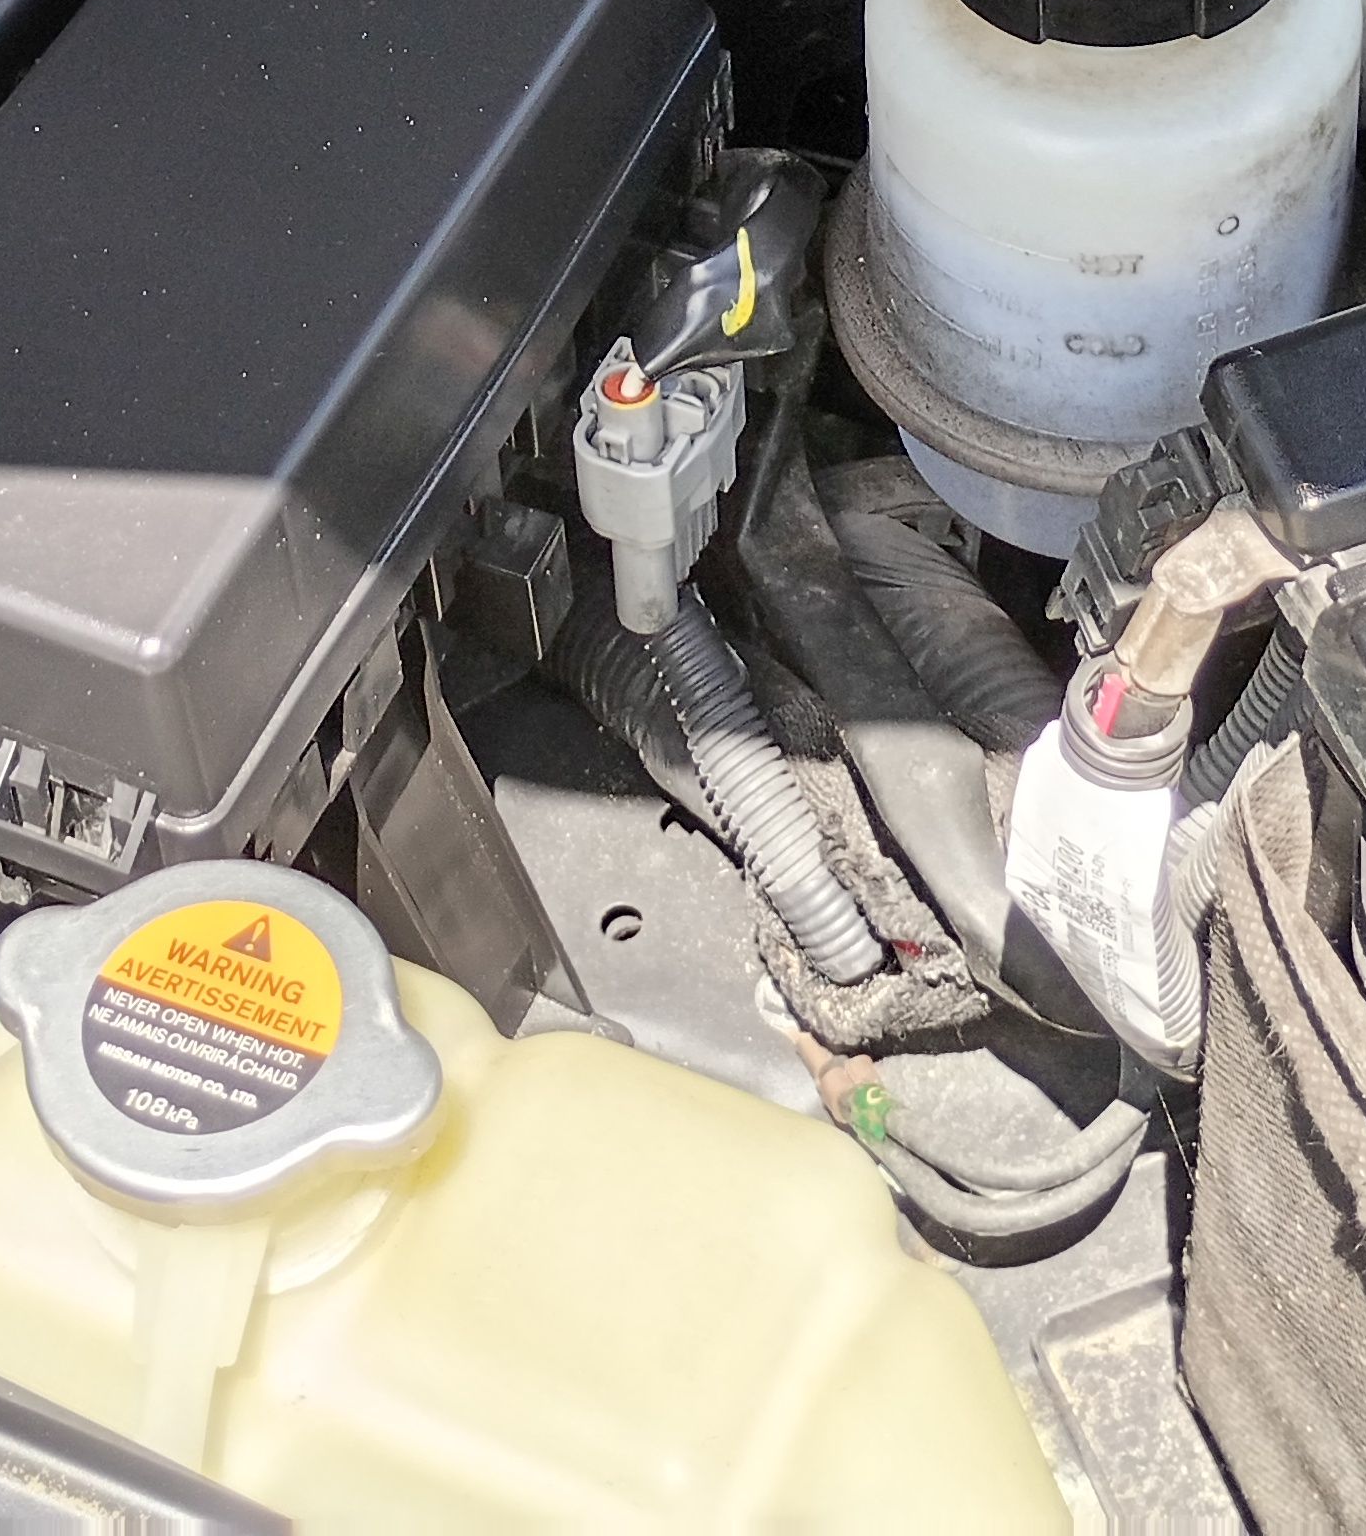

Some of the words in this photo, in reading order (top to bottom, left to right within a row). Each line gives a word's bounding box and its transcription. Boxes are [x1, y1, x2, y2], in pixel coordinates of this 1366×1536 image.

[115, 957, 328, 1043] AVERTISSEMENT
[167, 937, 307, 1006] WARNING
[88, 1002, 112, 1025] NE
[109, 1013, 169, 1045] JAMAIS
[167, 1032, 231, 1066] OUVRIR
[237, 1059, 299, 1091] CHAUD.
[103, 986, 162, 1018] NEVER
[160, 1007, 211, 1037] OPEN
[212, 1023, 266, 1056] WHEN
[265, 1043, 307, 1070] HOT.
[98, 1040, 152, 1069] NISSAN
[149, 1059, 203, 1089] MOTOR
[229, 1087, 259, 1108] LTD.
[123, 1087, 168, 1116] 108
[164, 1103, 201, 1130] kPa
